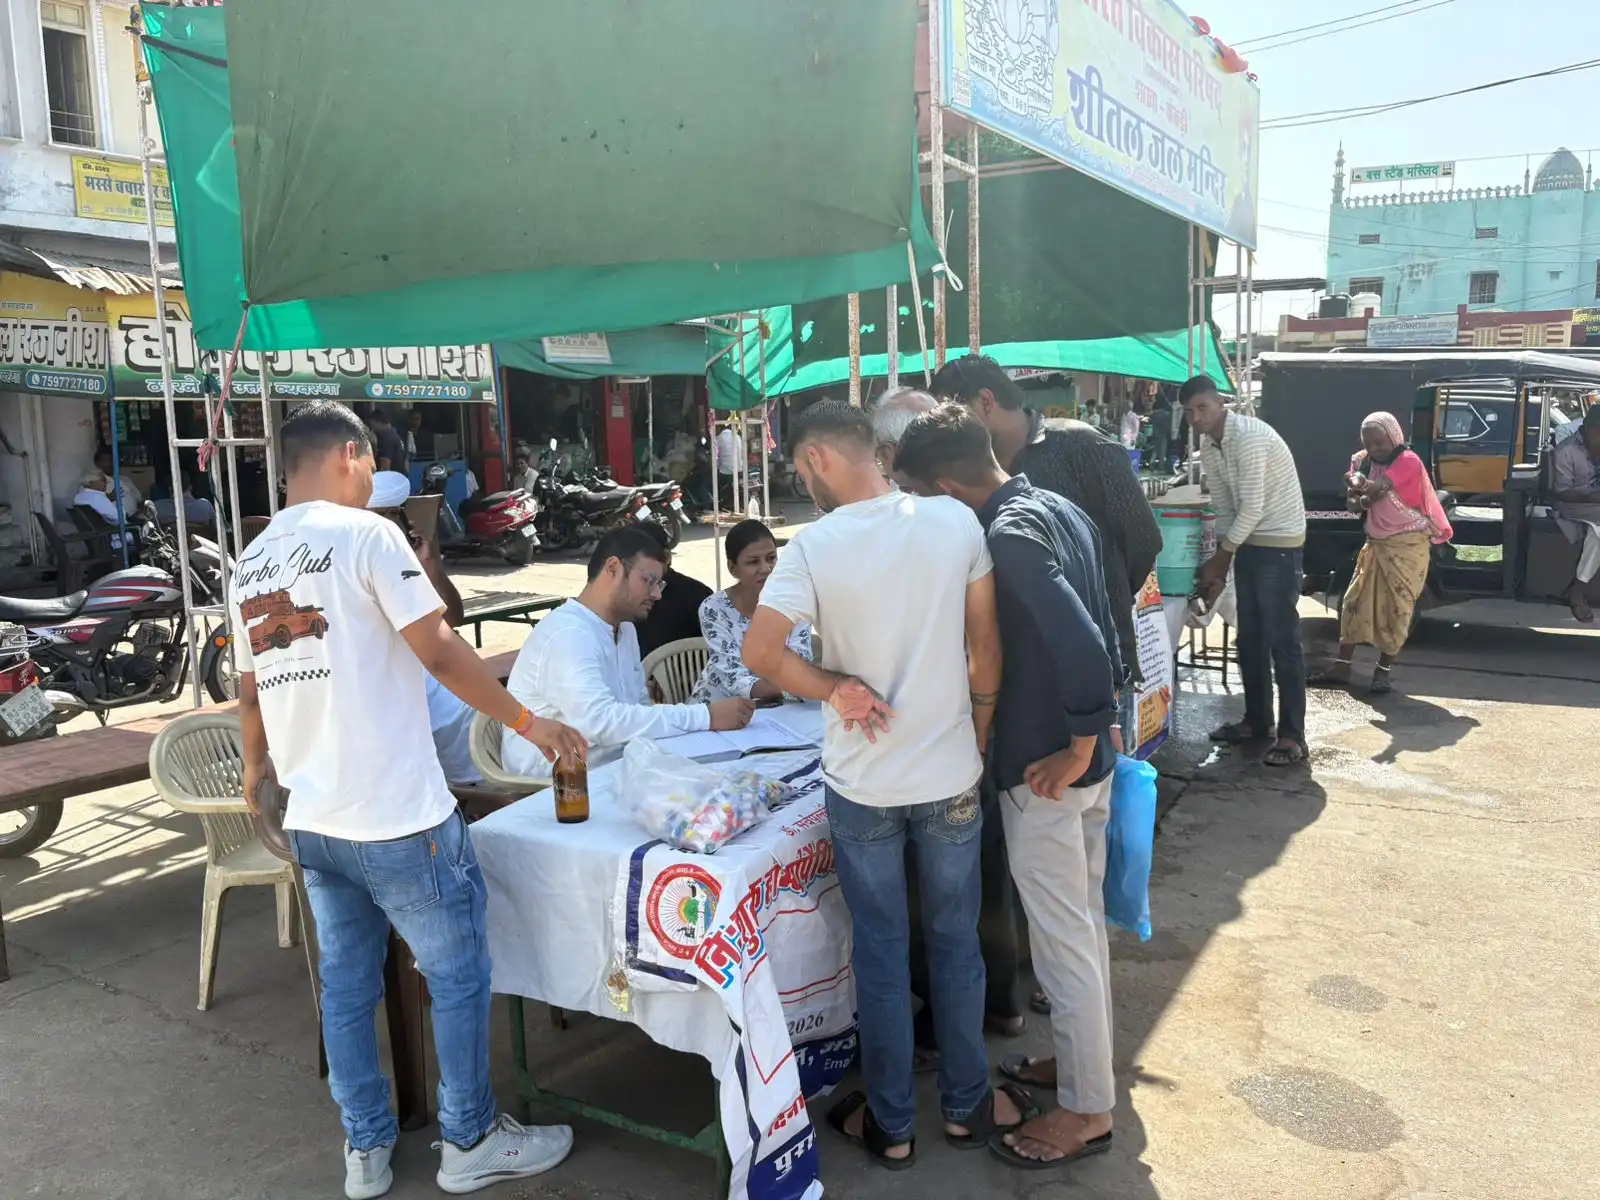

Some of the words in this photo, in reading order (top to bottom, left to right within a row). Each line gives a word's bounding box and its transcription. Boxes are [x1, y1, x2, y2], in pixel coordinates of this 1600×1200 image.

[1066, 65, 1146, 162] शीतल
[1146, 121, 1186, 183] जल
[1365, 169, 1381, 181] बस
[1405, 162, 1438, 178] मस्जिद
[42, 375, 100, 391] 7597727180
[145, 375, 201, 394] ठरने
[384, 384, 467, 397] 7597727180
[234, 547, 280, 590] Turbo
[278, 543, 333, 592] Club
[787, 1008, 824, 1036] 2026
